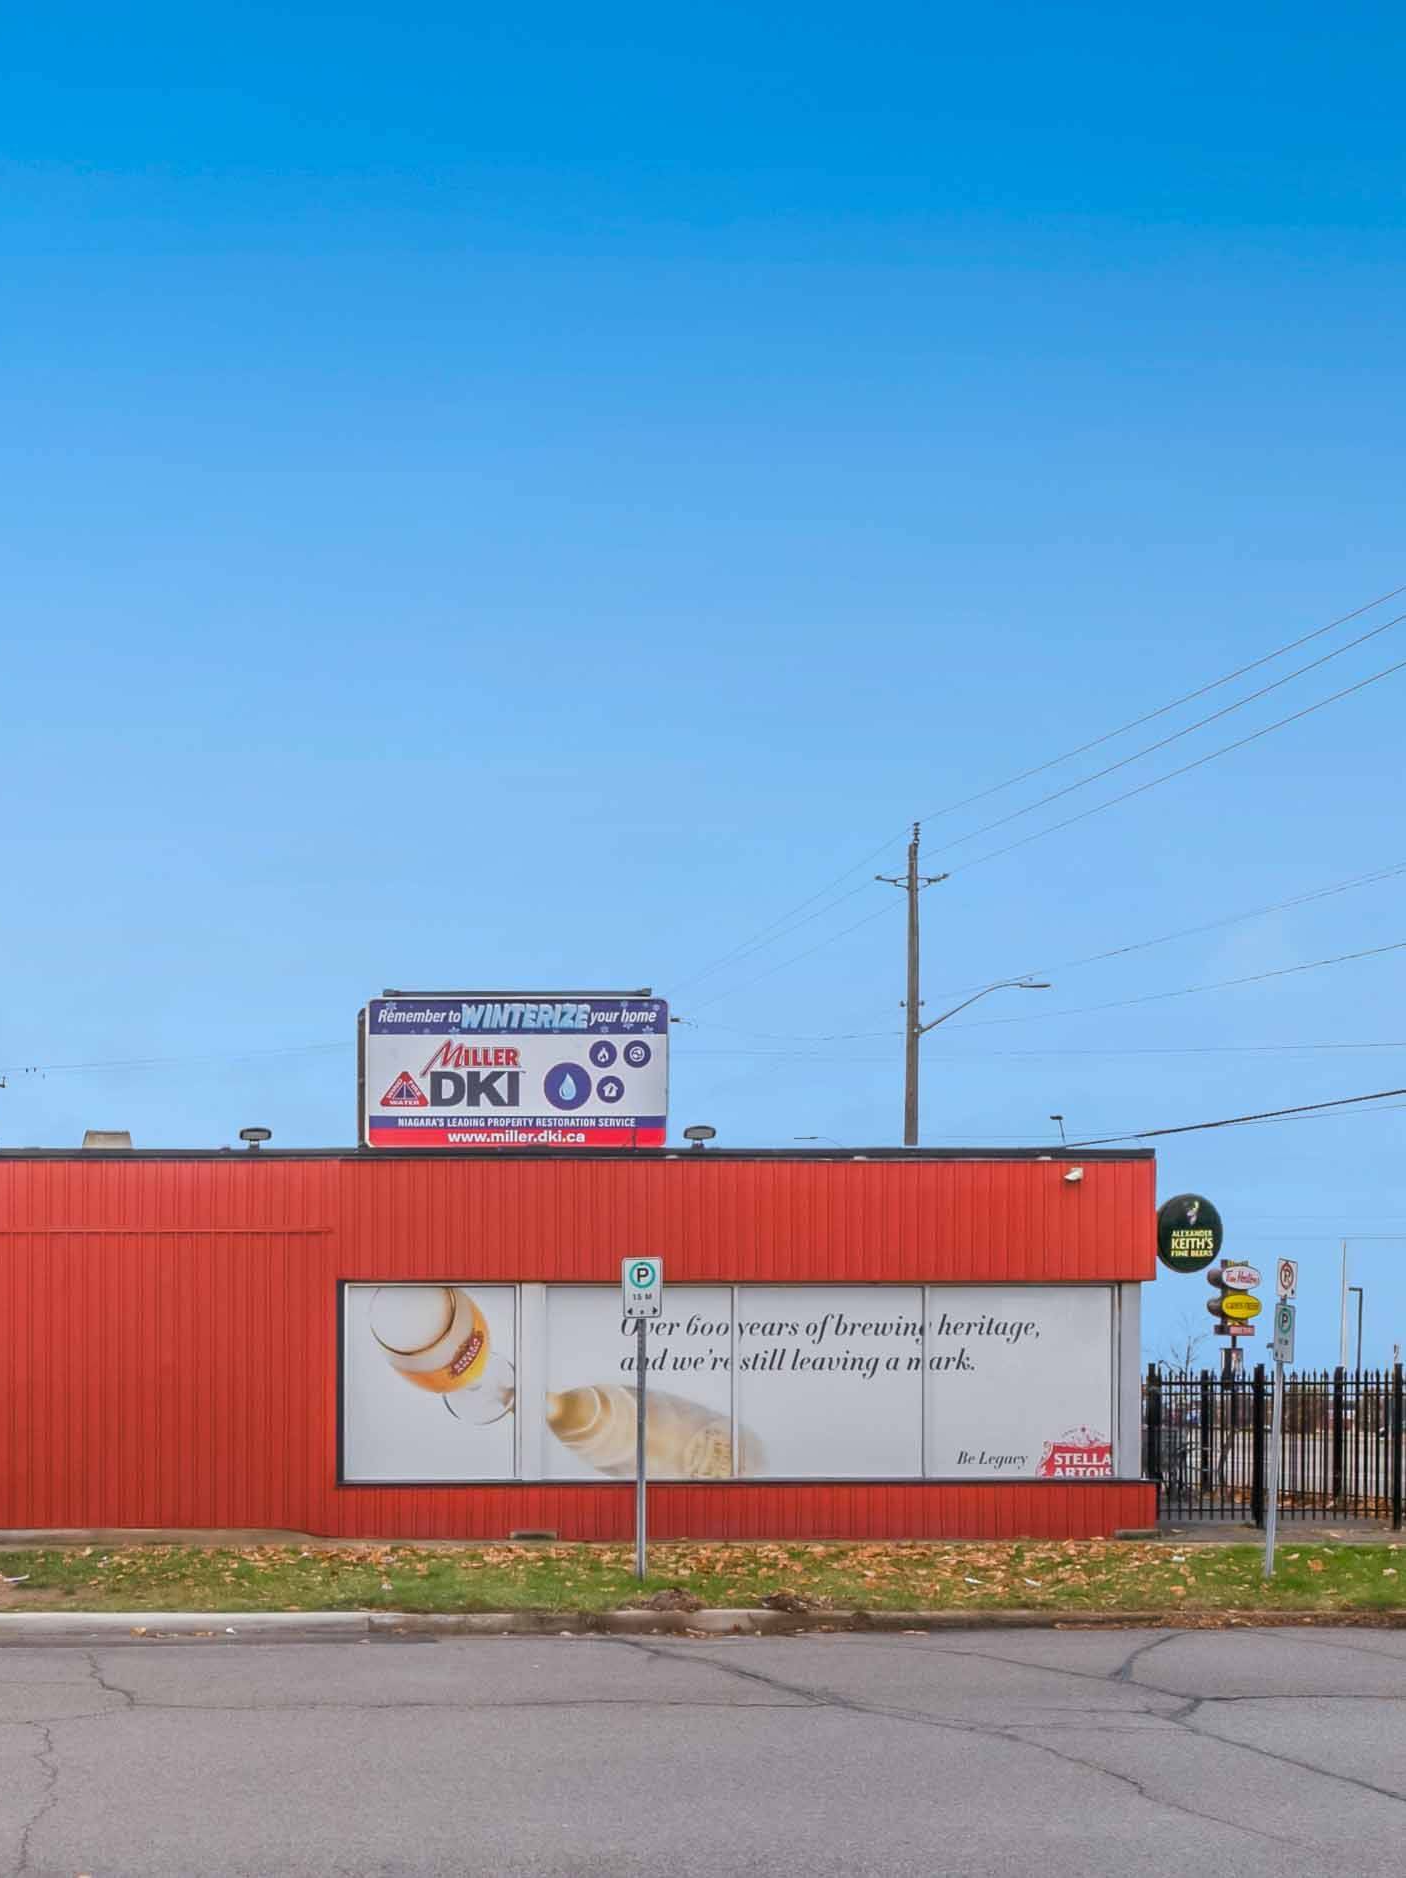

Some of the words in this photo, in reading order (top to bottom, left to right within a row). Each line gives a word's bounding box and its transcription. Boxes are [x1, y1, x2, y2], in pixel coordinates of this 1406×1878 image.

[378, 1009, 446, 1023] Remember
[448, 1010, 461, 1023] to
[461, 1003, 590, 1029] WINTERIZE
[589, 1011, 619, 1026] your
[621, 1009, 657, 1023] home
[430, 1070, 520, 1107] DKI
[398, 1118, 444, 1127] NIAGARA'S
[447, 1118, 485, 1127] LEADING
[487, 1118, 534, 1127] PROPERTY
[536, 1118, 596, 1127] RESTORATION
[598, 1118, 636, 1127] SERVICE
[447, 1130, 586, 1143] www.miller.dki.ca
[1171, 1230, 1213, 1238] ALEXANDER
[1171, 1238, 1214, 1249] KEITH'S
[637, 1268, 650, 1283] P
[686, 1313, 729, 1336] 600
[738, 1321, 799, 1344] years
[805, 1313, 835, 1345] of
[937, 1313, 1040, 1344] heritage,
[739, 1348, 787, 1371] still
[791, 1348, 880, 1379] leaving
[885, 1356, 900, 1371] a
[957, 1451, 975, 1465] Be
[979, 1451, 1029, 1470] Legacy
[1053, 1453, 1112, 1466] STELLA
